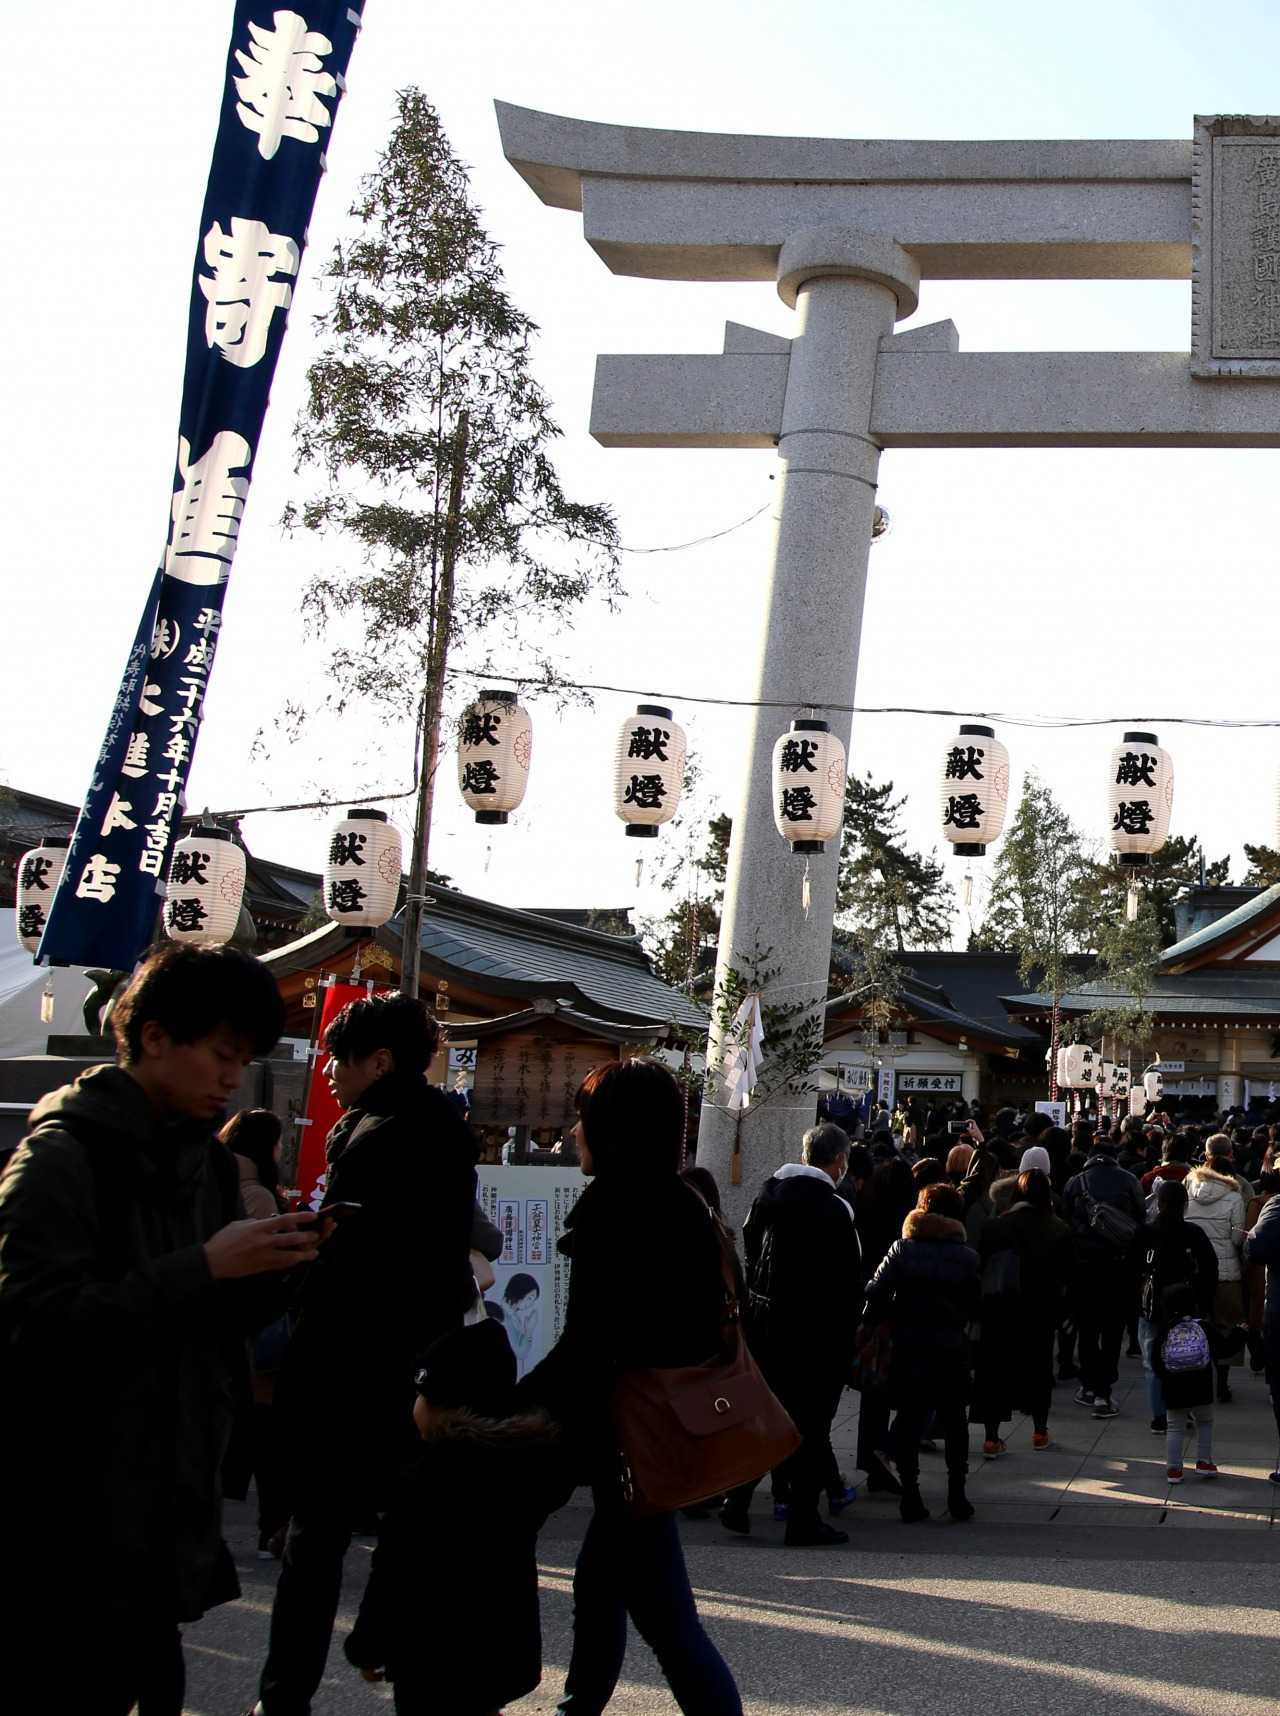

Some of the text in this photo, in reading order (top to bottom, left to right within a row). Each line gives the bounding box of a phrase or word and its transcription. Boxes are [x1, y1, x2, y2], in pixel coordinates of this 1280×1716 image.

[138, 608, 221, 877] 平成二十六年十月吉日
[624, 727, 670, 808] 献燈
[780, 740, 818, 821] 献燈
[944, 746, 984, 828] 献燈
[1112, 752, 1157, 834] 献燈
[168, 850, 210, 932] 献燈
[329, 831, 367, 914] 献燈
[904, 1077, 956, 1089] 祈願受付
